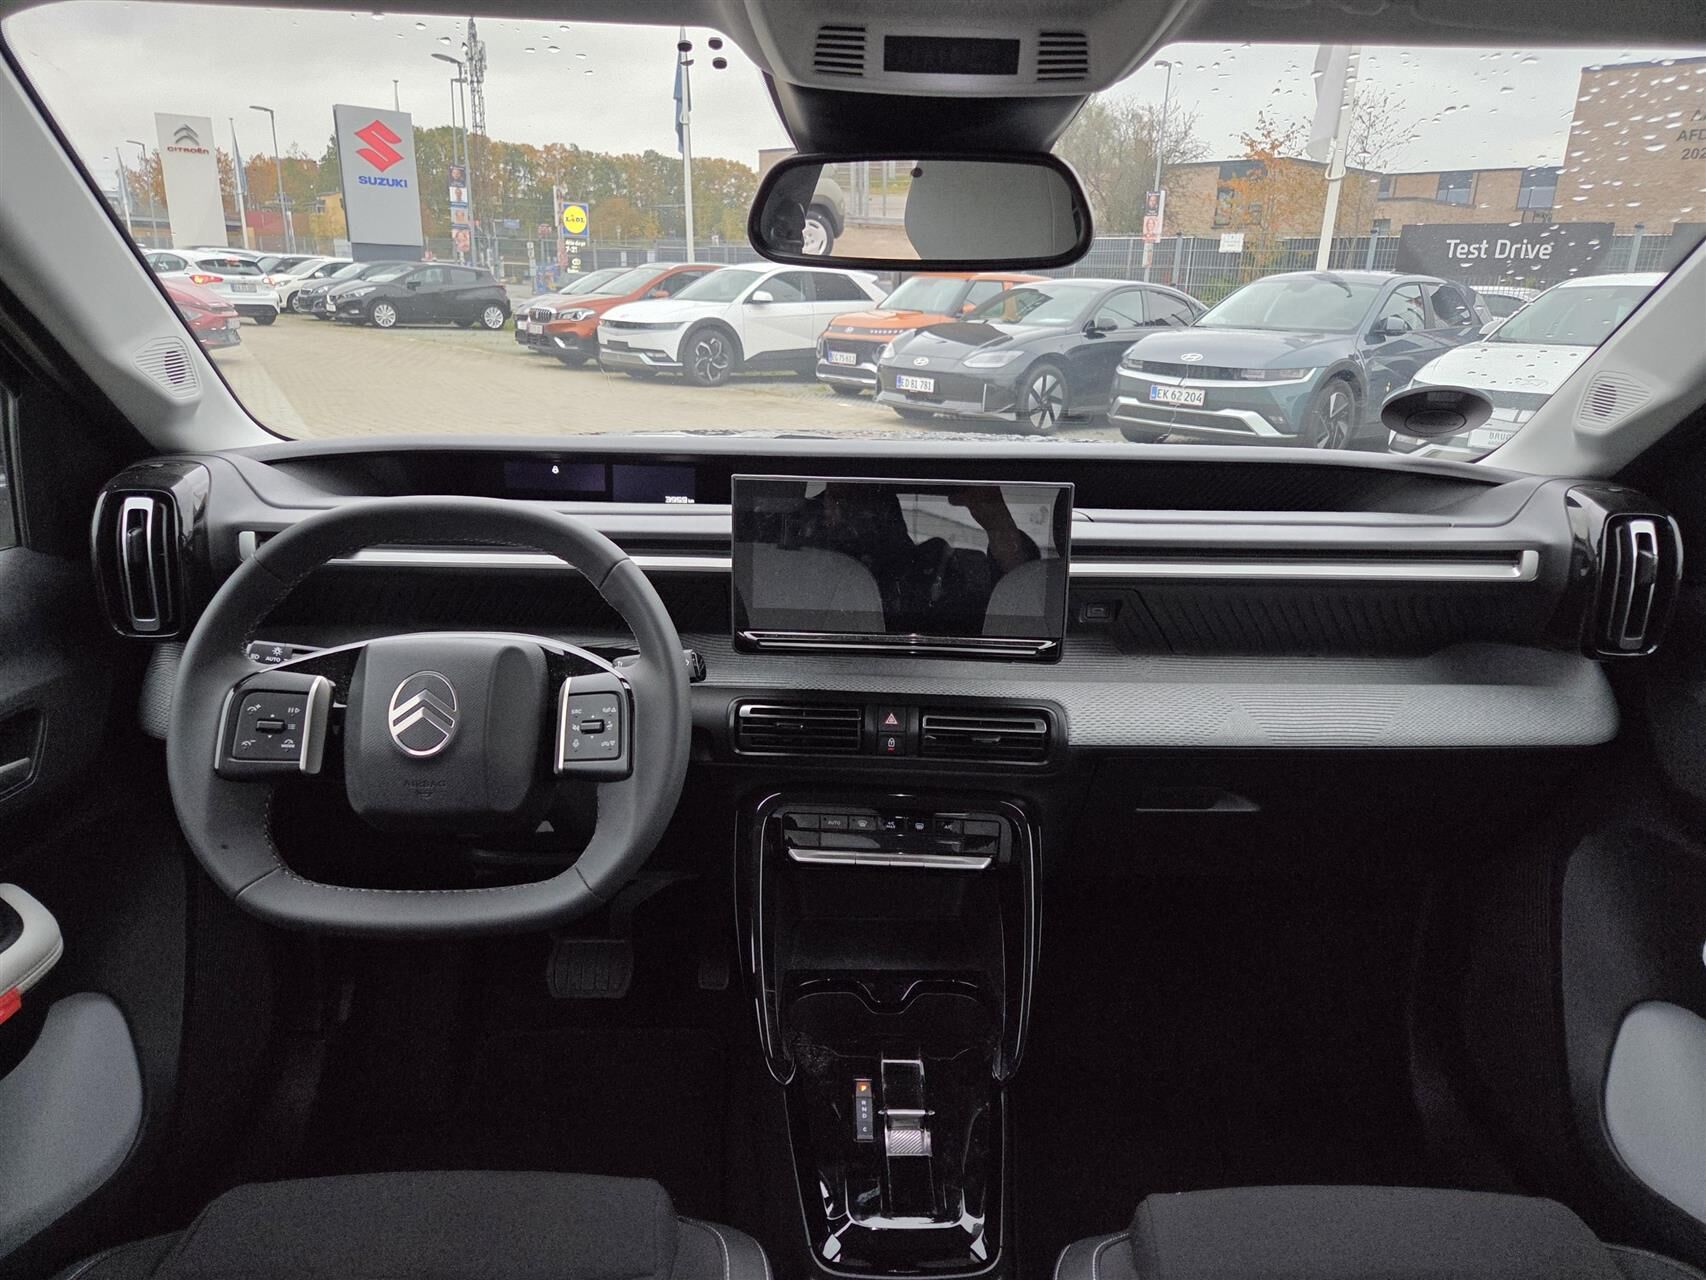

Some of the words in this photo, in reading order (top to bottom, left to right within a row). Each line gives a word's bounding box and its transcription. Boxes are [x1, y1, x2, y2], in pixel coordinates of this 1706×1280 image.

[358, 175, 408, 188] SUZUKI
[1446, 239, 1489, 259] Test
[1494, 238, 1553, 259] Drive
[911, 379, 918, 389] 81
[920, 380, 932, 391] 781
[1157, 389, 1169, 399] EK
[1171, 390, 1183, 401] 62
[1184, 391, 1202, 403] 204
[403, 779, 447, 788] AIRBAG
